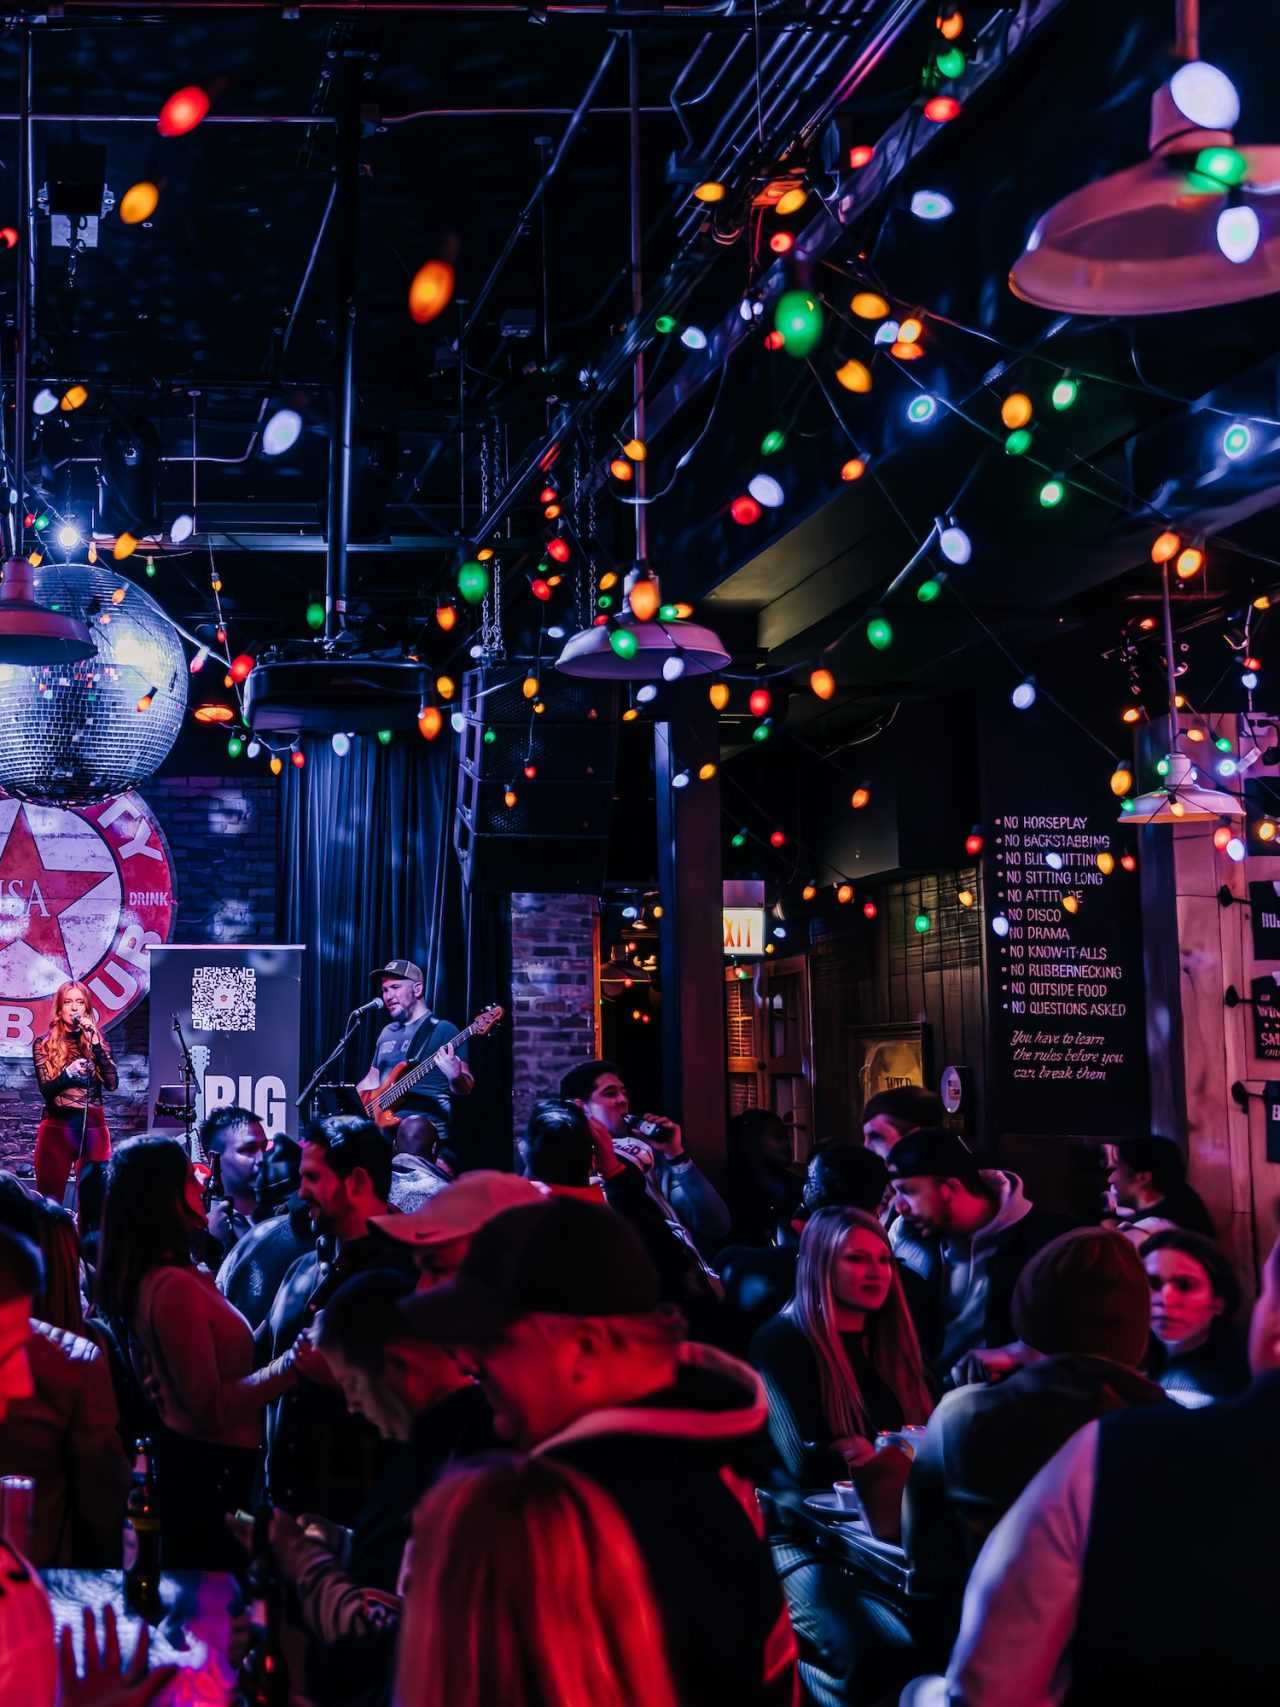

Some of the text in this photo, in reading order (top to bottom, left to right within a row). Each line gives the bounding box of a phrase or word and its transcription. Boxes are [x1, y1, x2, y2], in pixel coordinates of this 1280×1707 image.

[1004, 816, 1088, 830] NO HORSEPLAY
[1005, 834, 1111, 849] NO BACKSTABBING
[1006, 852, 1100, 867] NO BULITTIN
[1007, 871, 1104, 886] NO SITTING LONG
[129, 891, 169, 907] DRINK
[1008, 890, 1084, 904] NO ATTITE
[1009, 908, 1062, 922] NO DISCO
[723, 916, 753, 948] XIT
[1010, 927, 1070, 941] NO DRAMA
[1010, 946, 1108, 961] NO KNOW-IT-ALLS
[1010, 964, 1123, 979] NO RUBBERNECKING
[1011, 983, 1108, 998] NO OUTSIDE FOOD
[1012, 1001, 1126, 1017] NO QUESTIONS ASKED
[1010, 1030, 1105, 1046] You have to learn
[1012, 1048, 1124, 1067] the rules before you
[1013, 1065, 1106, 1081] can break them
